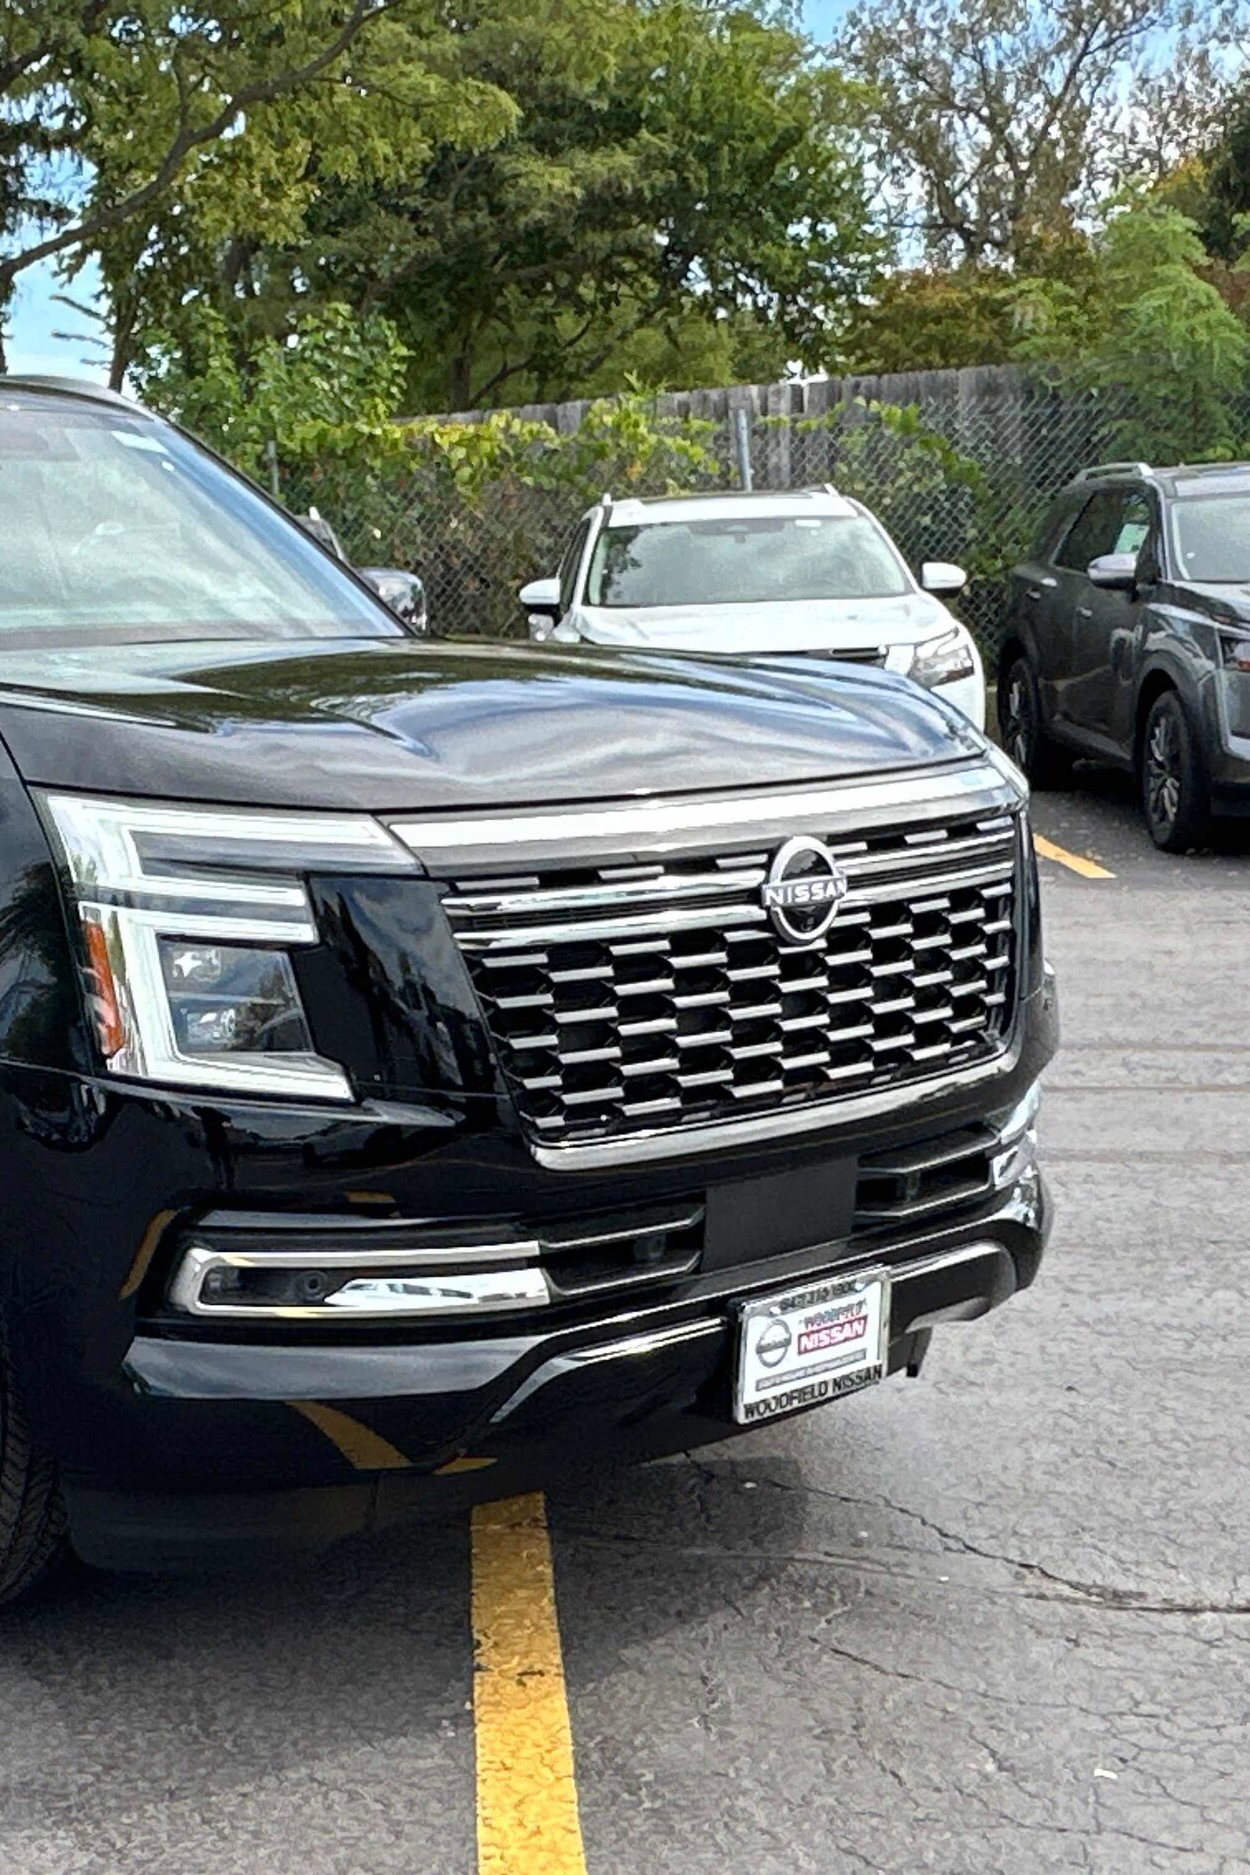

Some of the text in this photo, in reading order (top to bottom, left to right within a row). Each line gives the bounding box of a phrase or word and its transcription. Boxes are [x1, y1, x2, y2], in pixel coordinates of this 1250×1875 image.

[765, 880, 846, 905] NISSAN
[800, 1320, 865, 1351] NISSAN
[743, 1380, 829, 1419] WOODFIELD
[832, 1366, 882, 1392] NISSAN
